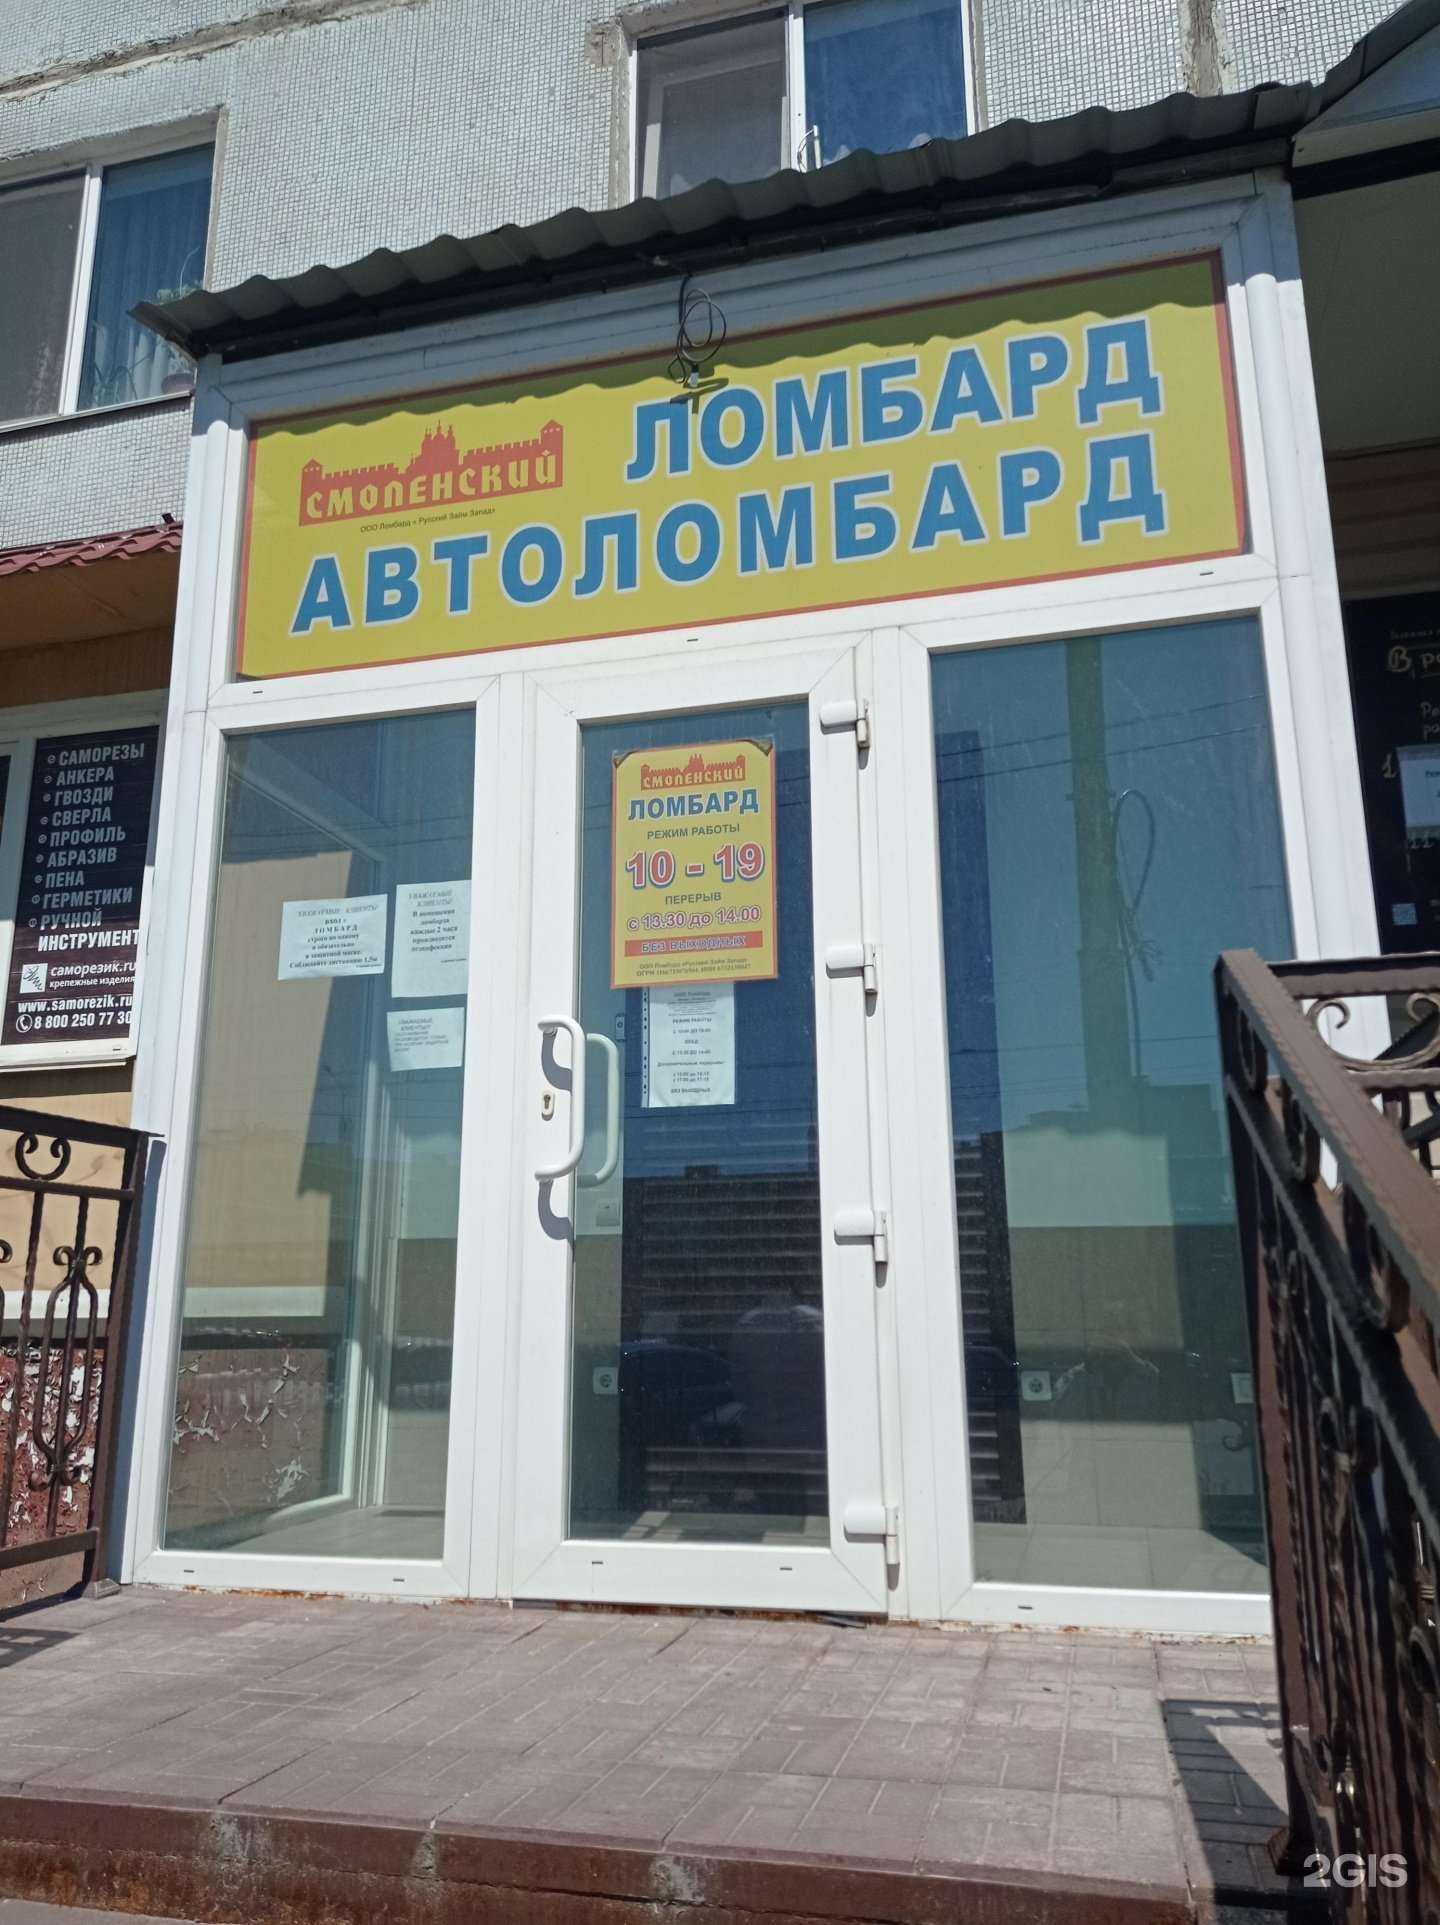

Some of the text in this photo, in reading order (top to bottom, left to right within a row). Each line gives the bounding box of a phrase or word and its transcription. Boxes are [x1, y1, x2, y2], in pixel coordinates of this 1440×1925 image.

[627, 318, 1163, 482] ЛОМБАРД
[306, 450, 556, 518] СМОЛЕНСКИЙ
[290, 432, 1168, 635] АВТОЛОМБАРД
[59, 743, 145, 766] САМОРЕЗЫ
[56, 766, 114, 786] АНКЕРА
[643, 766, 743, 787] СМОЛЕНСКИЙ
[54, 786, 113, 806] ГВОЗДИ
[628, 788, 759, 821] ЛОМБАРД
[52, 806, 111, 826] СВЕРЛА
[50, 826, 126, 847] ПРОФИЛЬ
[647, 824, 740, 840] РЕЖИМ РАБОТЫ
[47, 847, 117, 867] АБРАЗИВ
[626, 849, 674, 889] 10
[713, 842, 765, 883] 19
[45, 870, 84, 889] ПЕНА
[42, 887, 132, 909] ГЕРМЕТИКИ
[665, 891, 722, 905] ПЕРЕРЫВ
[40, 908, 102, 930] РУЧНОЙ
[688, 912, 713, 928] до
[38, 929, 139, 952] ИНСТРУМЕНТ
[641, 941, 666, 952] БЕЗ
[49, 977, 98, 990] крепежные
[18, 995, 132, 1013] www.samorezik.ru
[34, 1017, 42, 1029] 8
[45, 1015, 68, 1029] 800
[72, 1013, 95, 1027] 250
[99, 1011, 114, 1025] 77
